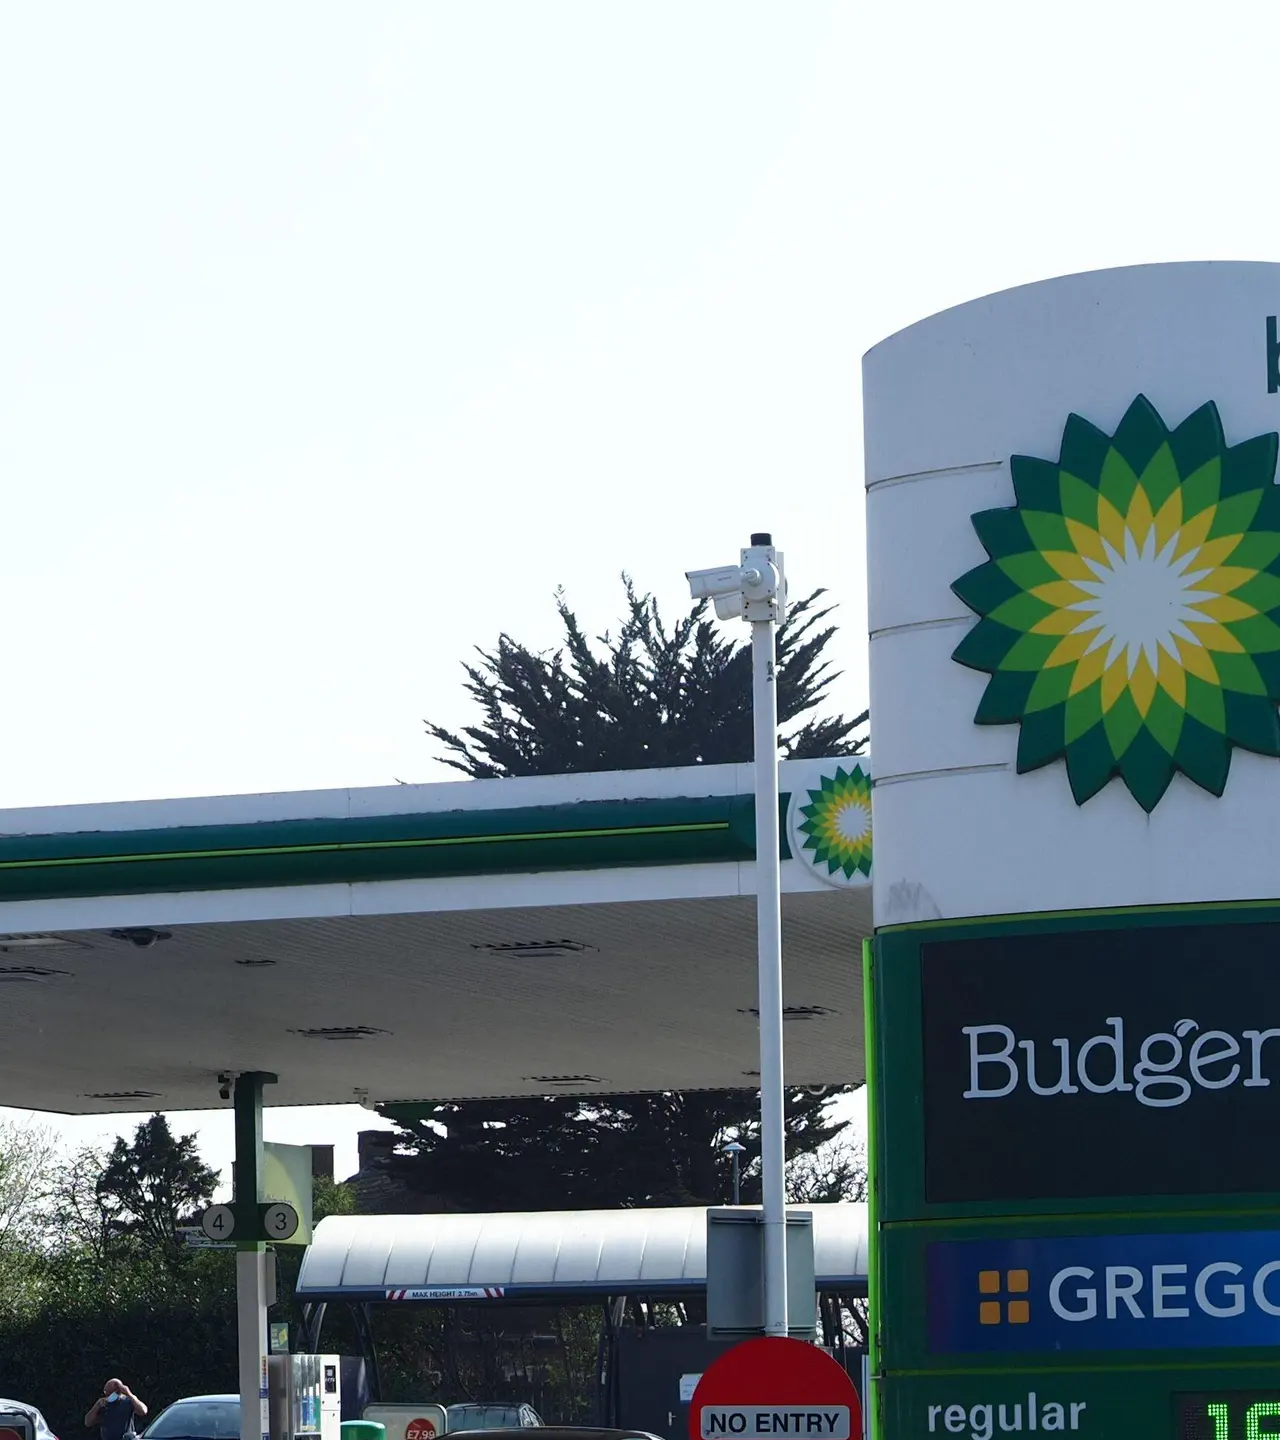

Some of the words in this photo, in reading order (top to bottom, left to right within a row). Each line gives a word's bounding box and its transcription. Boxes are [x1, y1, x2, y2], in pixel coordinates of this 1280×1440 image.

[212, 1213, 224, 1231] 4
[275, 1212, 286, 1231] 3
[429, 1290, 457, 1298] HEIGHT
[710, 1412, 747, 1434] NO
[755, 1413, 840, 1433] ENTRY
